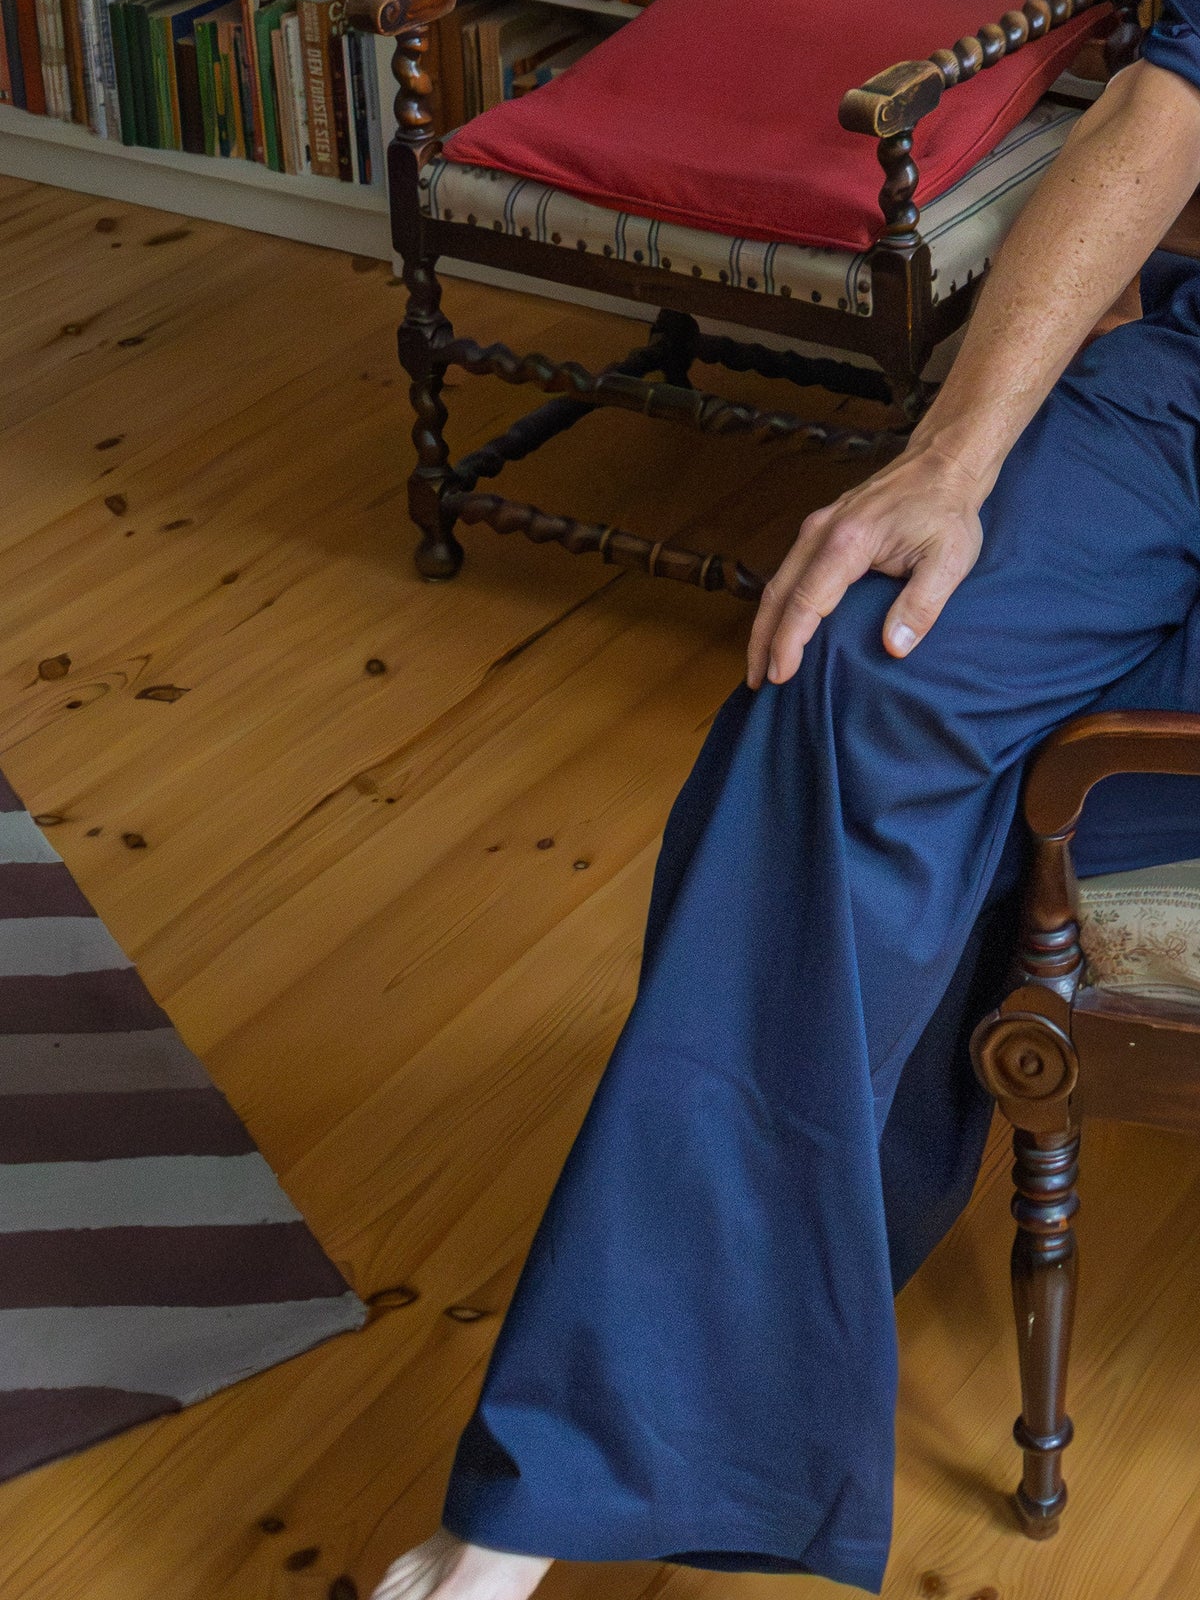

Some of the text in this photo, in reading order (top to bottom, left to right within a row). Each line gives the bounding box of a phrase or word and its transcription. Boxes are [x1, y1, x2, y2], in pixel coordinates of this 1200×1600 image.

[306, 48, 323, 77] DEN
[310, 78, 328, 126] FØRSTE
[315, 127, 331, 163] STEN
